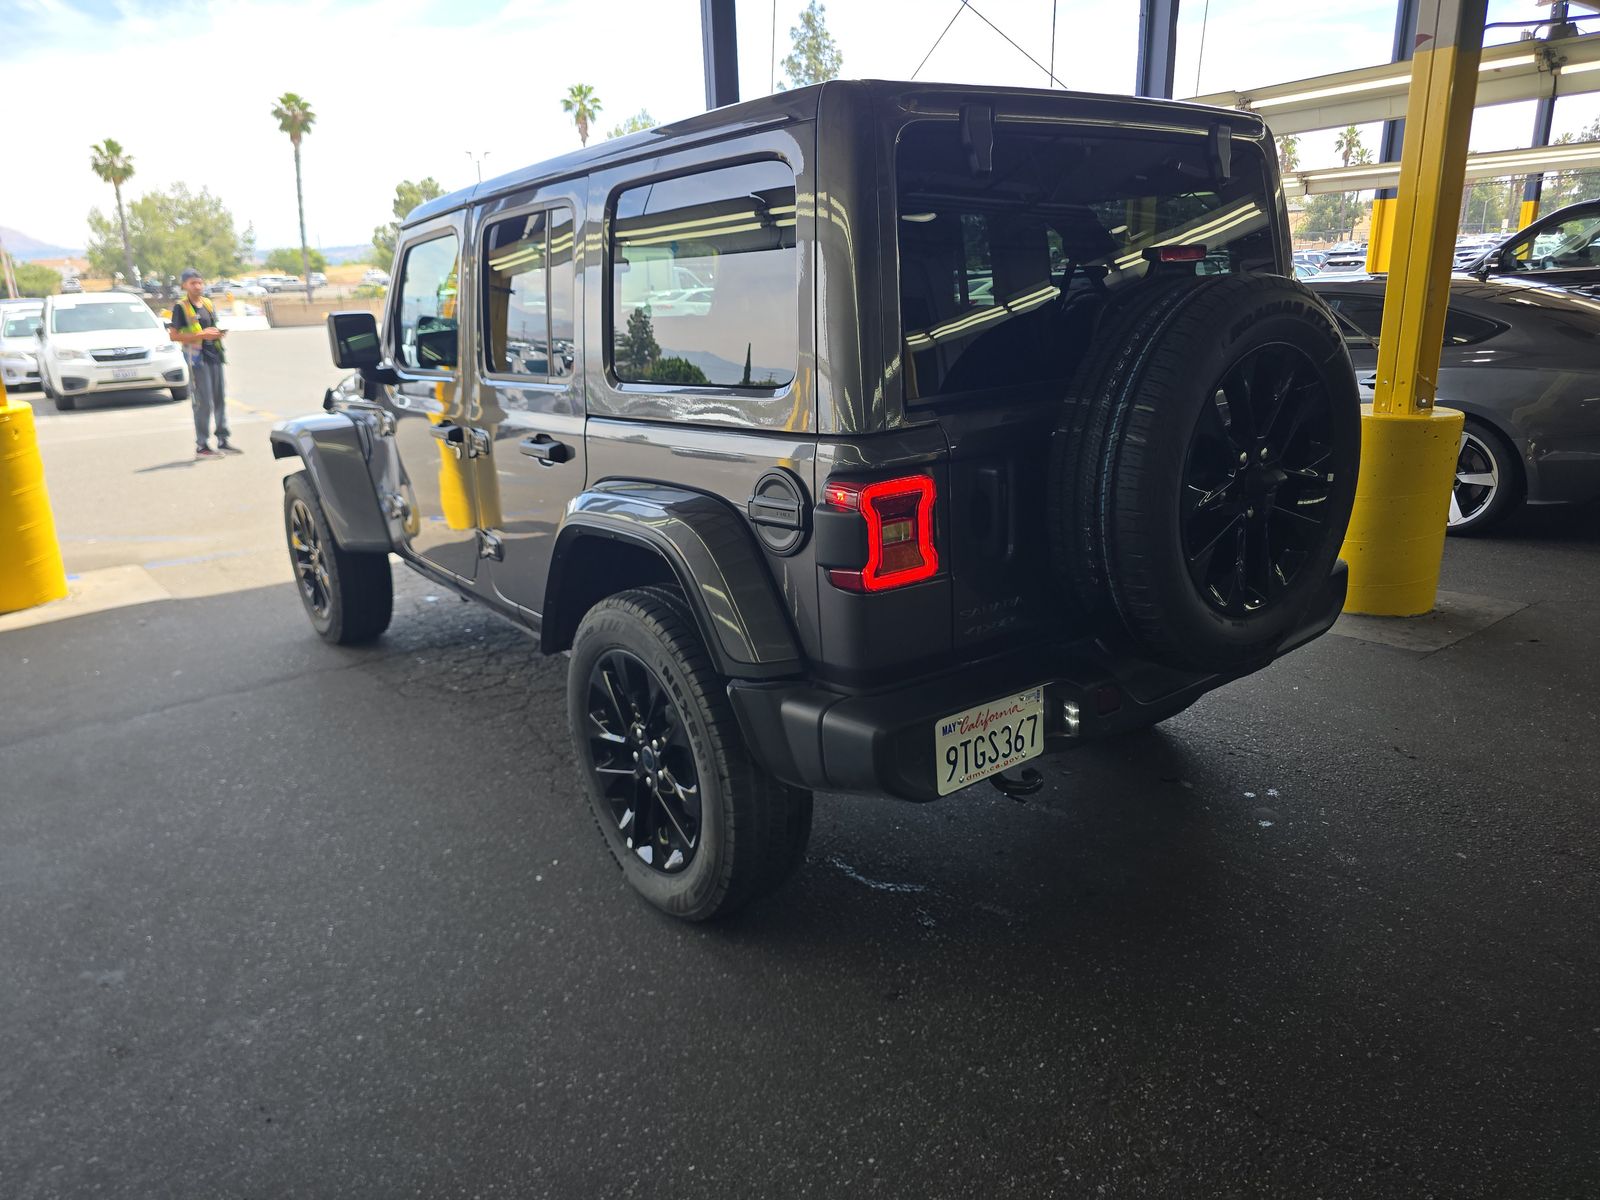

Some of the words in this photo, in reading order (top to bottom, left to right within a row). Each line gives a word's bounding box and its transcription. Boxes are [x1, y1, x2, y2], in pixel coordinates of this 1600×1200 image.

[662, 664, 706, 761] NEXEN
[941, 720, 957, 737] MAY
[959, 701, 1025, 736] California
[946, 714, 1038, 783] 9TGS367
[966, 755, 1020, 781] dmv.ca.gov
